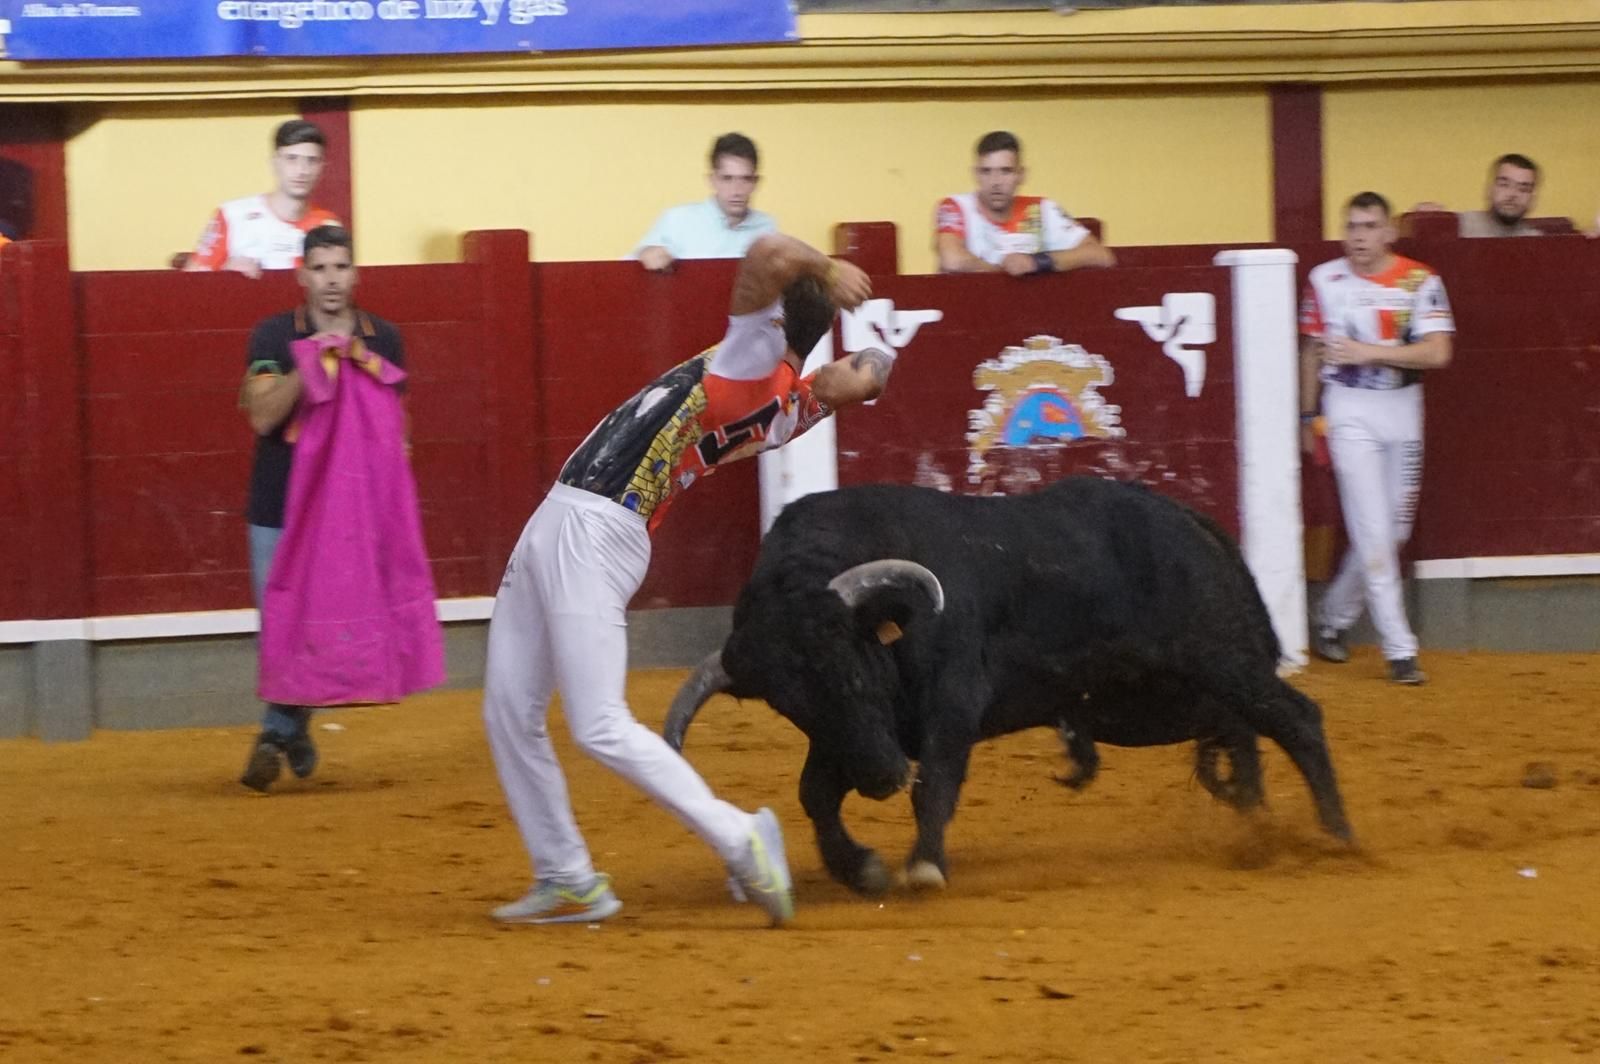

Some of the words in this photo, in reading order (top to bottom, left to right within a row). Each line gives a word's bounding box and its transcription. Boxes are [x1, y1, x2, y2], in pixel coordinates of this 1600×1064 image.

[377, 0, 421, 20] de
[424, 0, 479, 19] luz
[479, 0, 502, 25] y
[509, 0, 568, 25] gas
